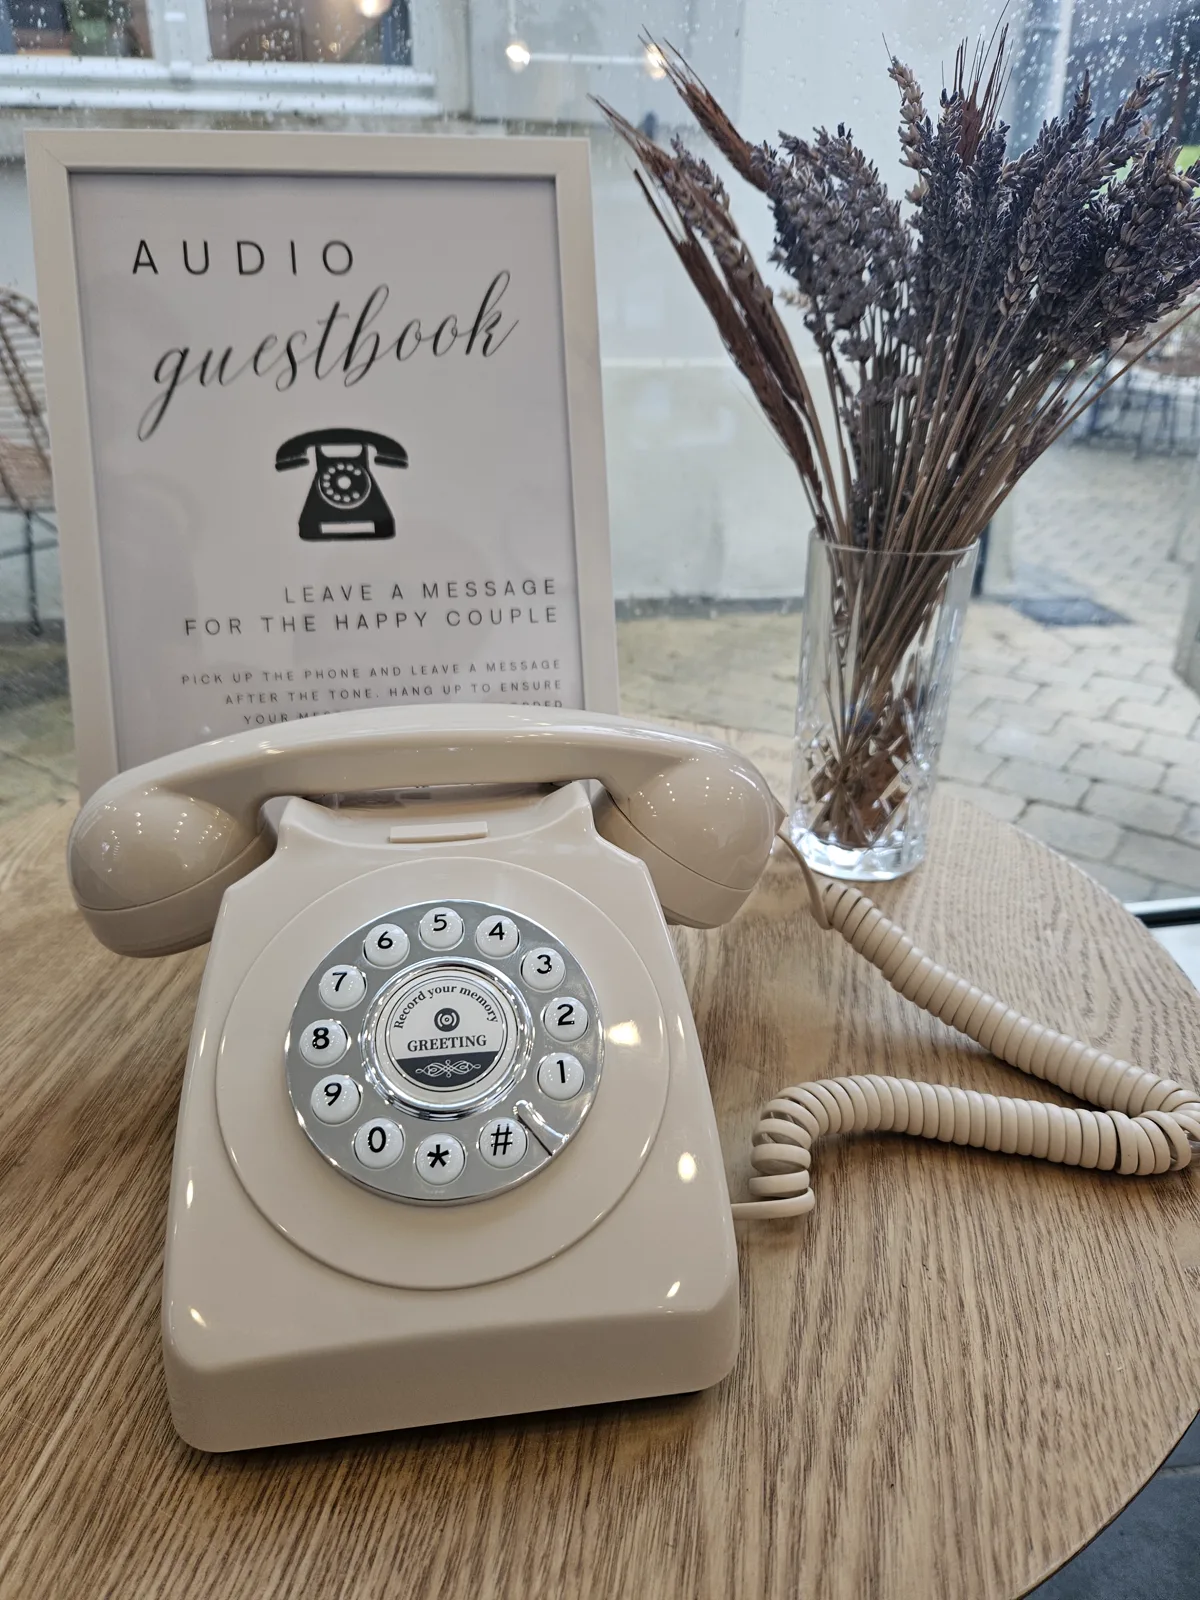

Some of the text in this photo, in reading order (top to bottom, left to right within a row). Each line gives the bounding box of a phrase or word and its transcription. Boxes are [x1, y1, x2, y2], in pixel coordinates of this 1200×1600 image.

[131, 238, 355, 276] AUDIO
[138, 270, 520, 442] guestbook
[284, 578, 557, 604] LEAVE A MESSAGE
[184, 606, 558, 637] FOR THE HAPPY COUPLE
[180, 659, 561, 686] PICK UP THE PHONE AND LEAVE A MESSAGE
[225, 692, 279, 705] AFTER
[287, 690, 320, 702] THE
[389, 685, 434, 698] HANG
[442, 684, 463, 696] UP
[470, 683, 492, 695] TO
[499, 679, 562, 693] ENSURE
[243, 712, 289, 725] YOUR
[432, 913, 448, 932] 5
[488, 921, 506, 941] 4
[376, 930, 394, 950] 6
[536, 954, 553, 975] 3
[332, 971, 349, 993] 7
[394, 985, 499, 1029] Record your memory
[556, 1003, 576, 1027] 2
[311, 1026, 331, 1050] 8
[407, 1034, 488, 1053] GREETING
[556, 1059, 567, 1084] 1
[323, 1082, 343, 1107] 9
[367, 1126, 387, 1154] 0
[490, 1124, 513, 1157] #
